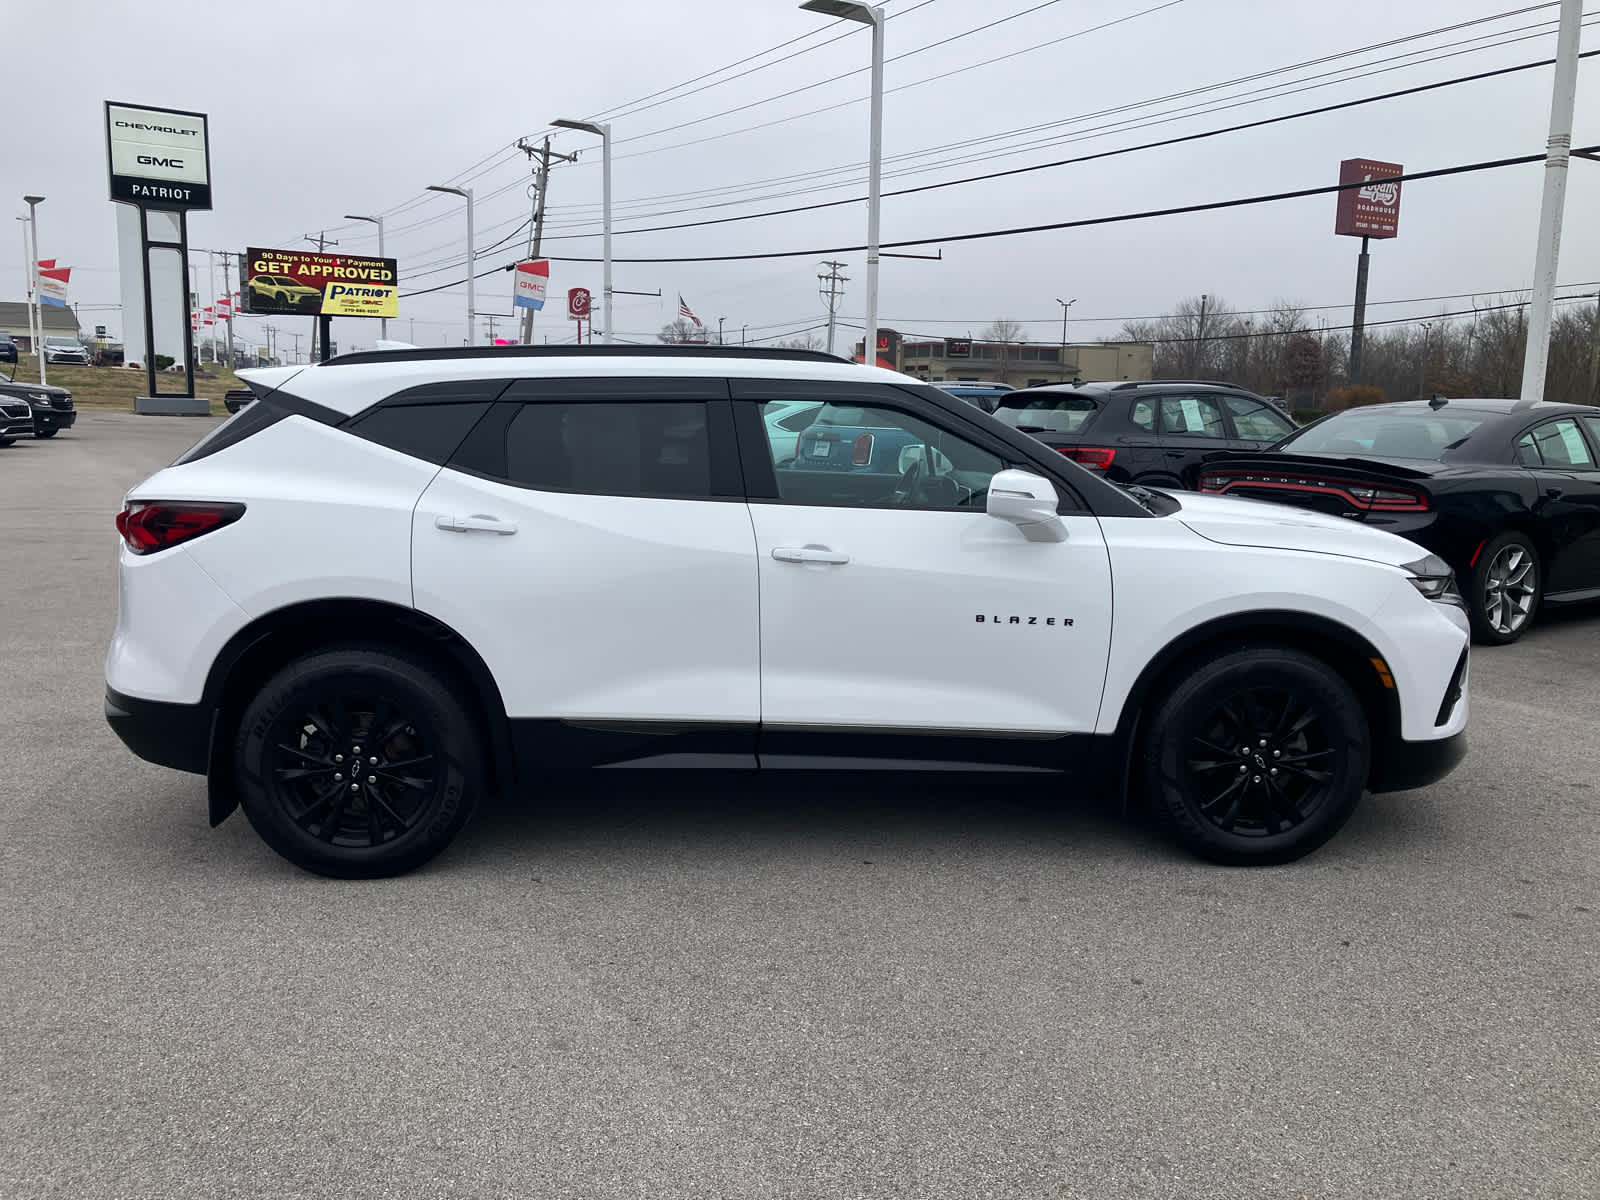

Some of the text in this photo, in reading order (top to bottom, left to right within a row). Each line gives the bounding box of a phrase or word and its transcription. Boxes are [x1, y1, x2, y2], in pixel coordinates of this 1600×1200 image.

[115, 121, 198, 136] CHEVROLET
[137, 155, 184, 168] GMC
[132, 184, 191, 200] PATRIOT
[1357, 204, 1396, 214] ROADHOUSE
[276, 253, 298, 263] Days
[301, 254, 311, 262] to
[313, 256, 333, 265] Your
[347, 258, 385, 269] Payment
[254, 261, 393, 281] GET APPROVED
[330, 285, 392, 299] PATRIOT
[520, 281, 545, 292] GMC
[975, 614, 1074, 627] BLAZER
